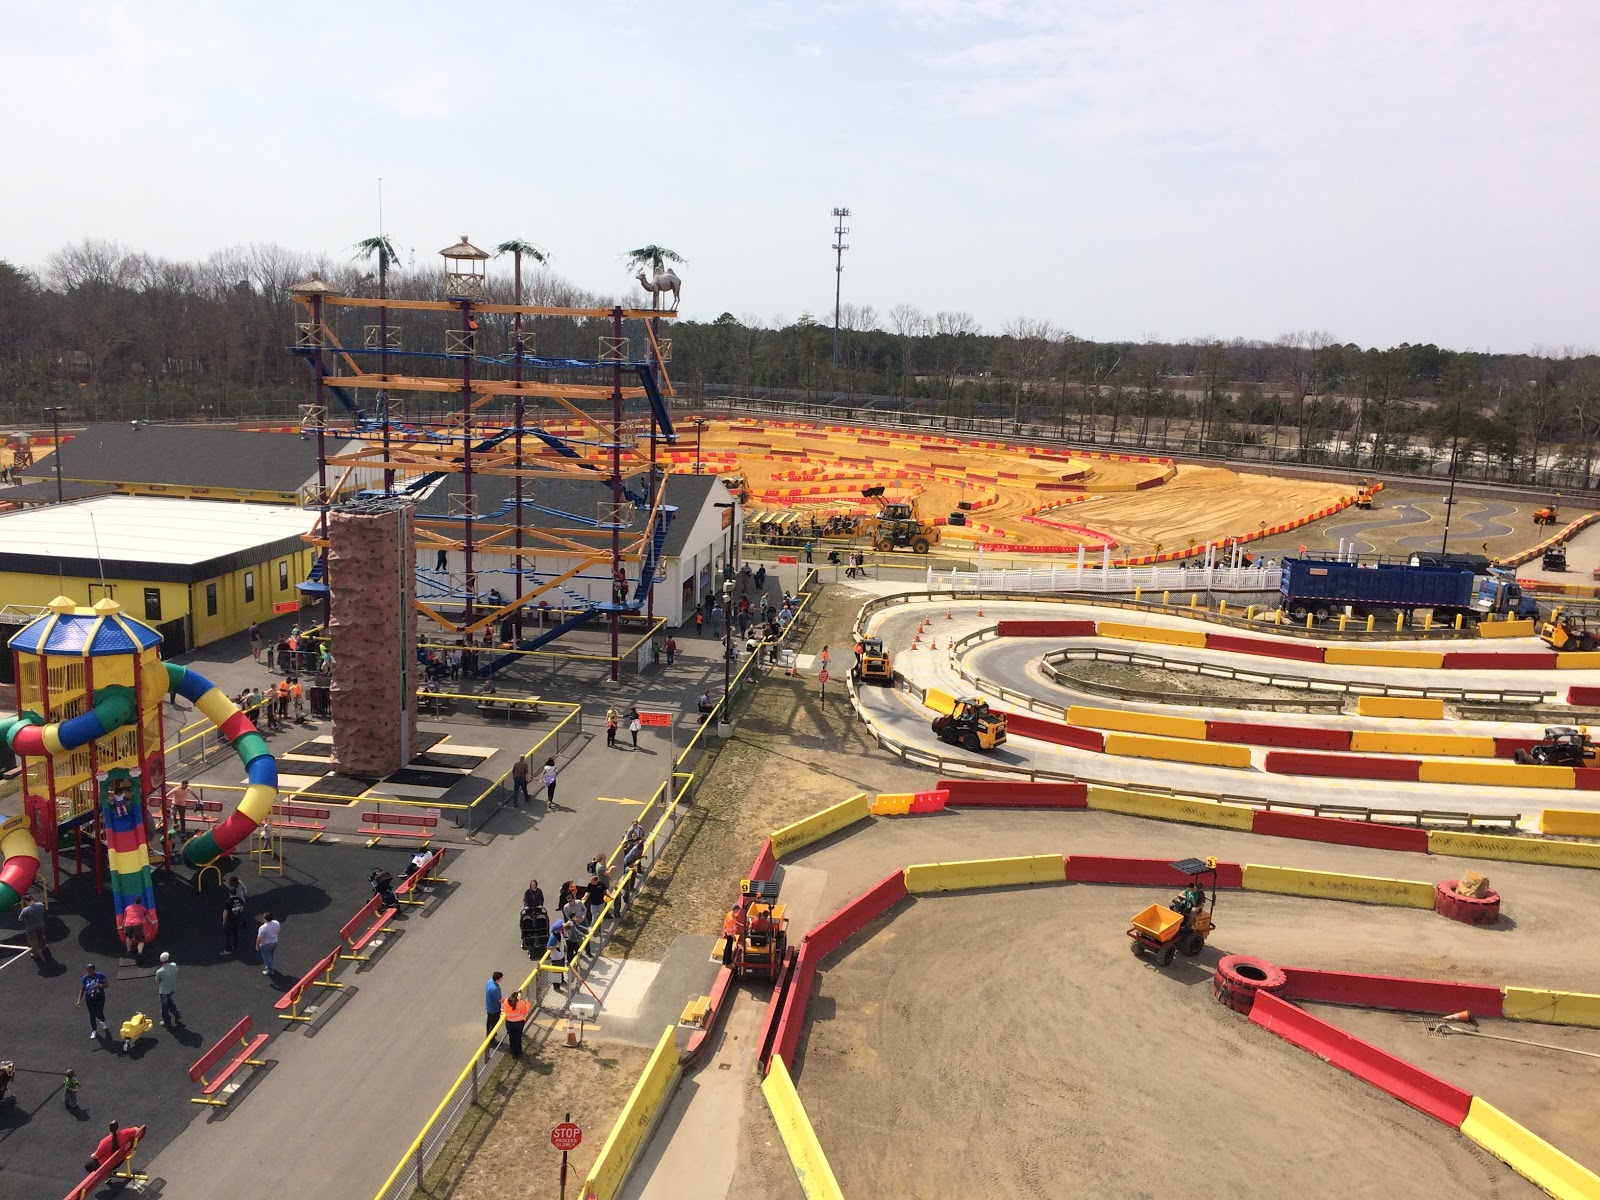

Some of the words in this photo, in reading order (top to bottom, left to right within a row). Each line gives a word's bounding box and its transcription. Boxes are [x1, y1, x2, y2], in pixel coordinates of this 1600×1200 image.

[1207, 859, 1213, 867] 3
[741, 884, 748, 892] 9
[553, 1128, 580, 1138] STOP
